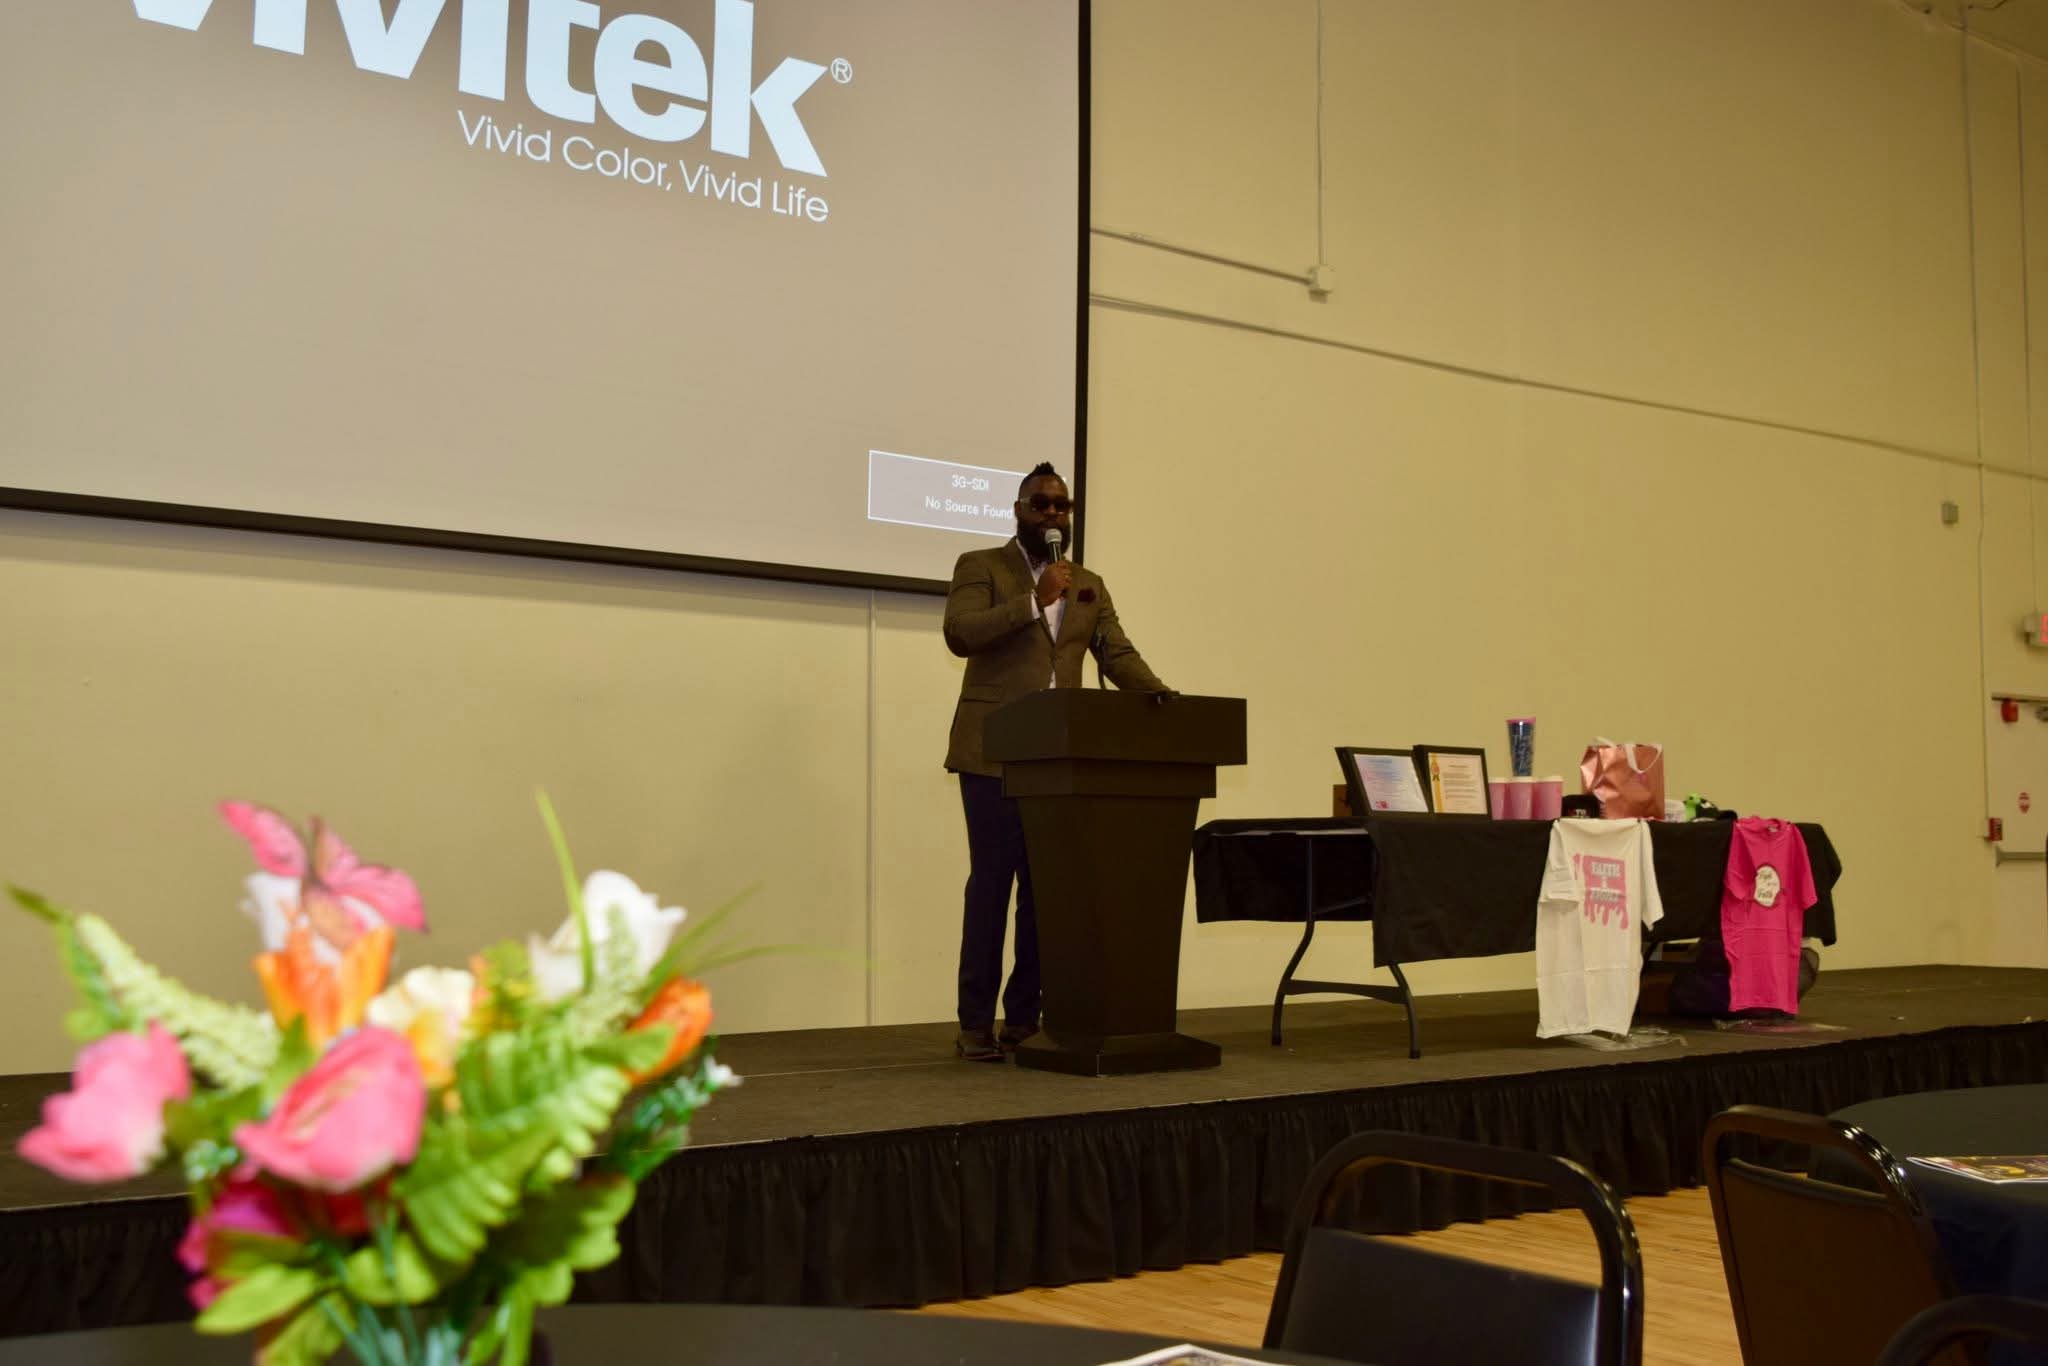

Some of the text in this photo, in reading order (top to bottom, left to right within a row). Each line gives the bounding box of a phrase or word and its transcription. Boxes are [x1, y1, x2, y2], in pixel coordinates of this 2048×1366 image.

[457, 109, 829, 223] Vivid Color, Vivid Life
[952, 474, 989, 491] 3G-SDI
[925, 495, 1013, 519] No Source Found
